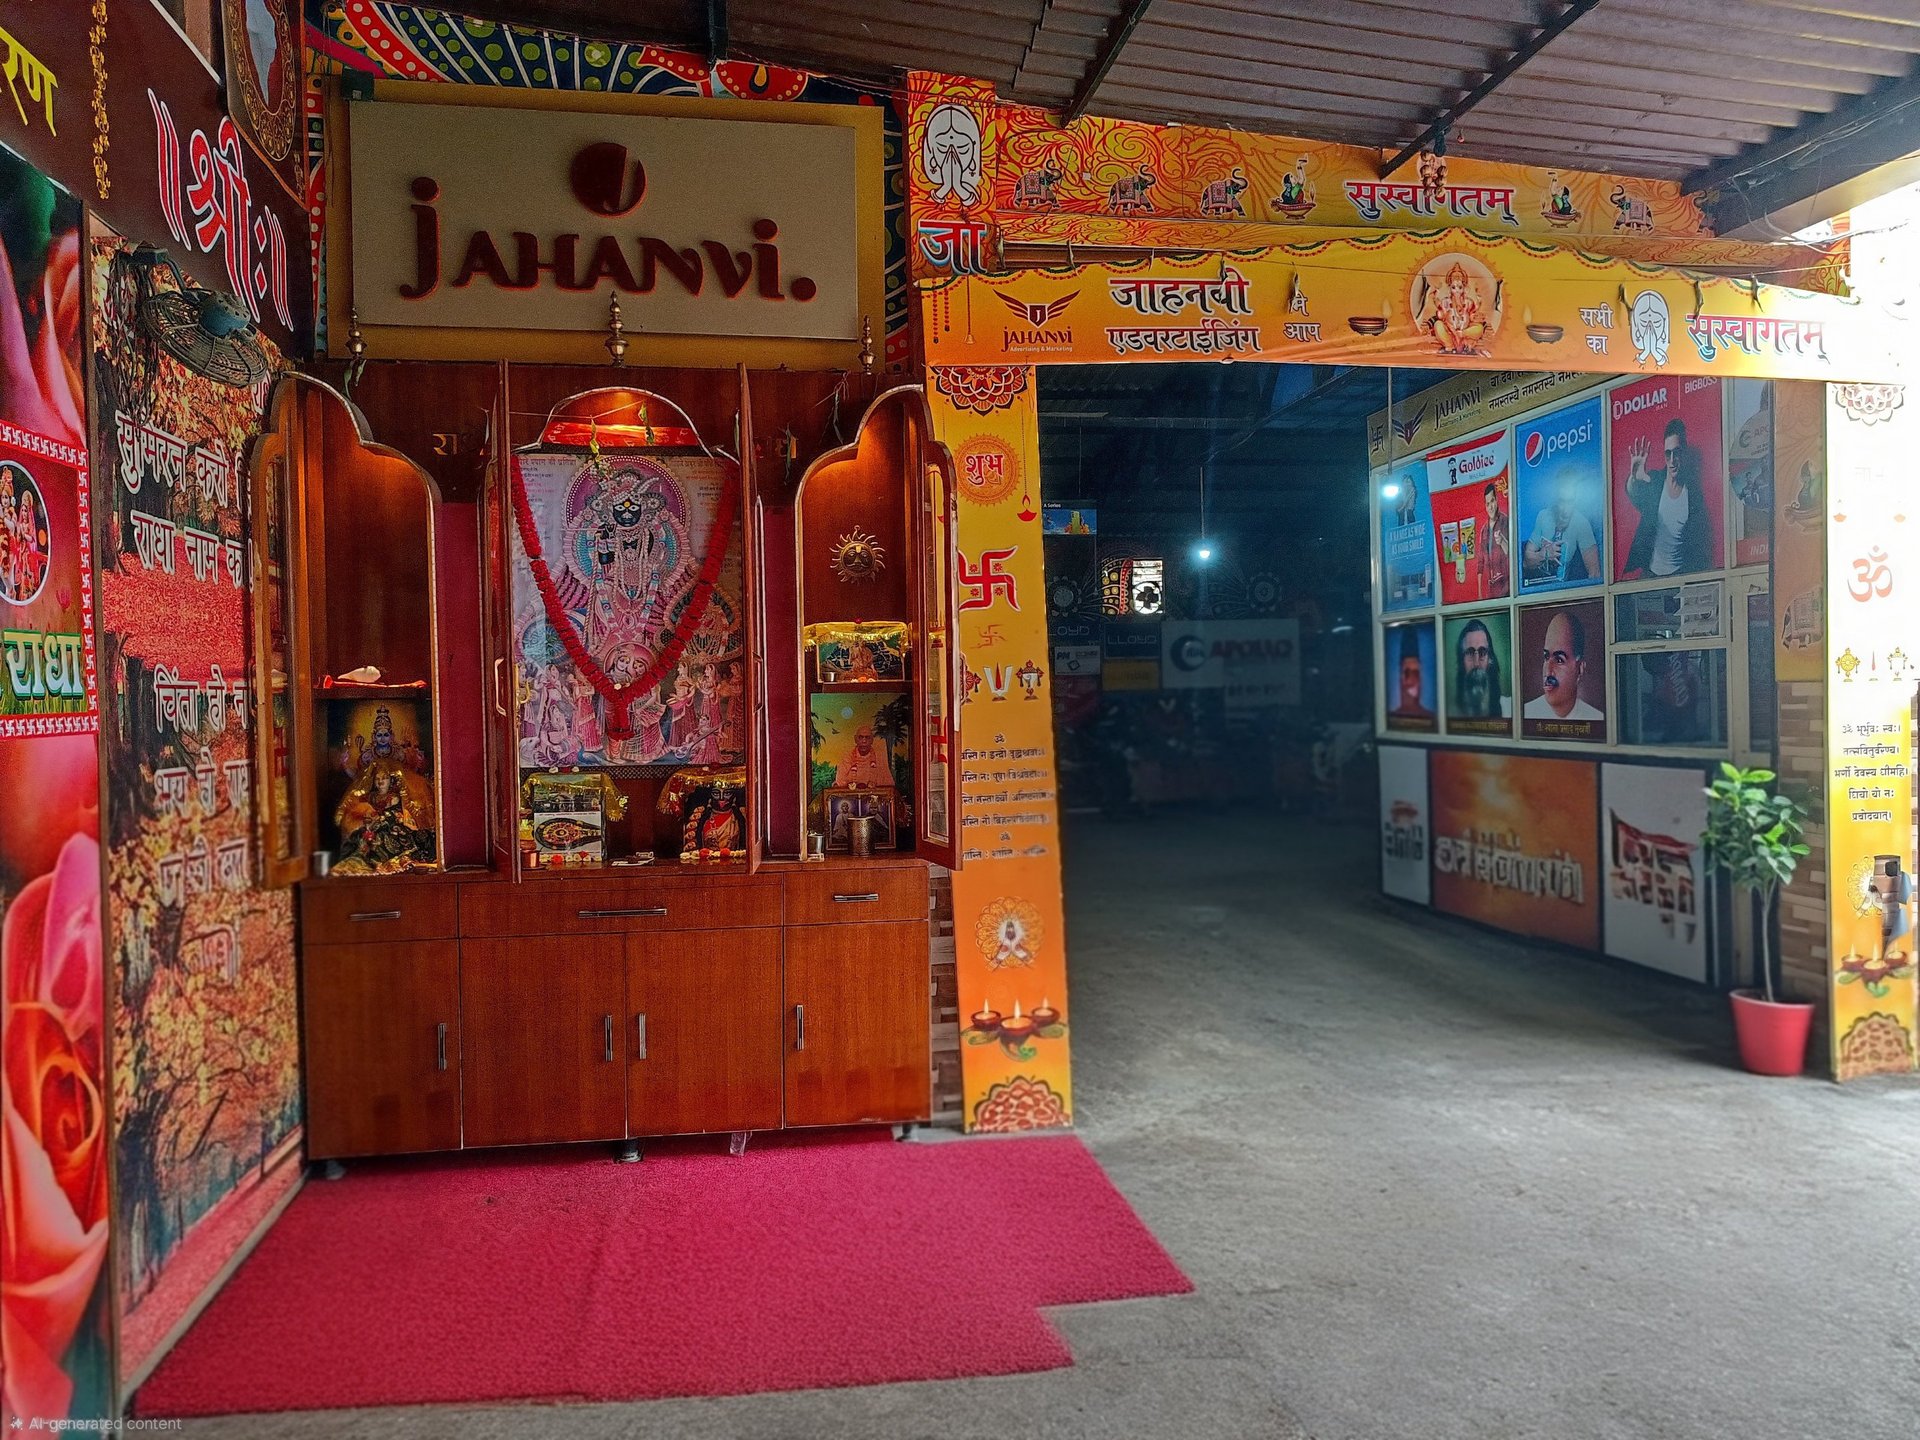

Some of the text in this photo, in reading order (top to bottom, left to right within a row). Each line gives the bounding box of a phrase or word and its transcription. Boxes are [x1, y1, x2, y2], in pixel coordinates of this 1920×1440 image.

[1283, 322, 1323, 343] आप
[1579, 302, 1614, 330] सभी
[1586, 333, 1609, 355] का
[1685, 313, 1832, 364] सुस्वागतम्
[1624, 387, 1667, 415] DOLLAR
[1546, 419, 1593, 459] pepsi
[965, 453, 1005, 486] शुभ
[130, 509, 176, 576] राधा
[184, 526, 219, 585] नाम
[3, 629, 86, 700] राधा
[206, 663, 227, 732] हो
